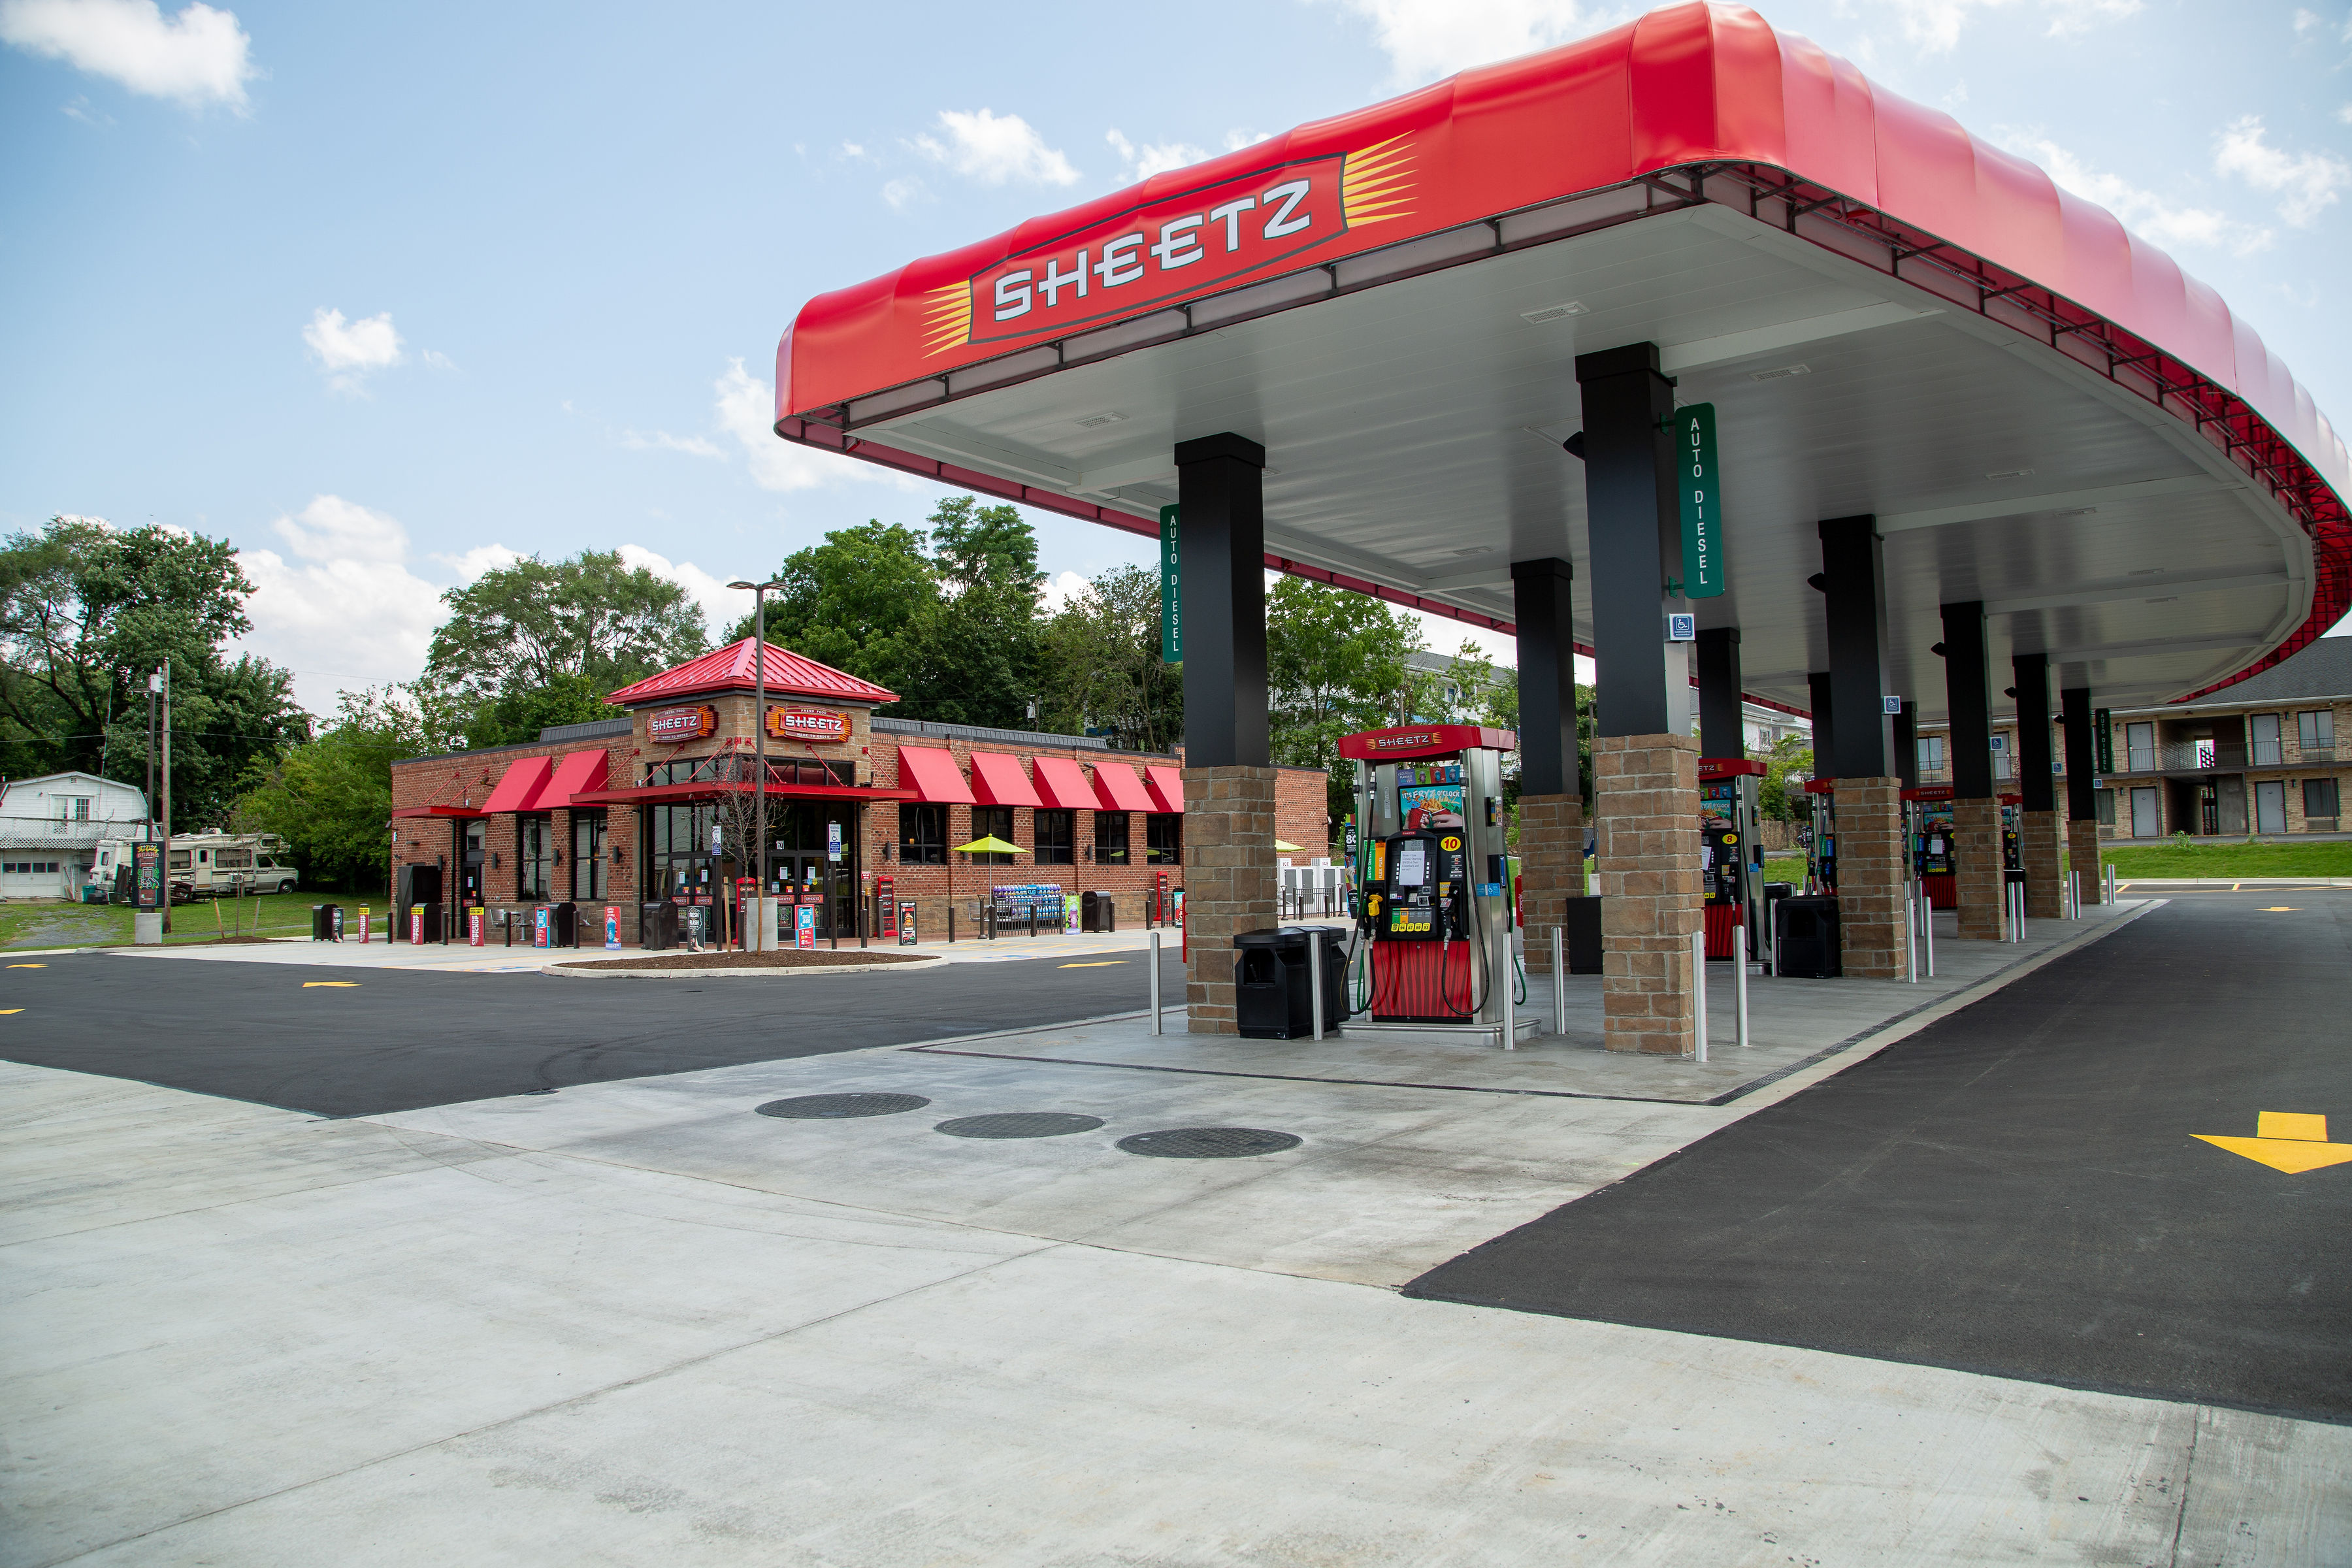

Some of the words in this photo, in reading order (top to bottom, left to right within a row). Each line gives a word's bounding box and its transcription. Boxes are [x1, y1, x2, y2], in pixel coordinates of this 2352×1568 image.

[994, 177, 1311, 321] SHEETZ
[1690, 417, 1702, 478] AUTO
[1694, 490, 1708, 585] DIESEL
[653, 716, 697, 731] SHEETZ
[785, 715, 841, 731] SHEETZ
[1379, 735, 1429, 747] SHEETZ
[1444, 839, 1458, 849] 10
